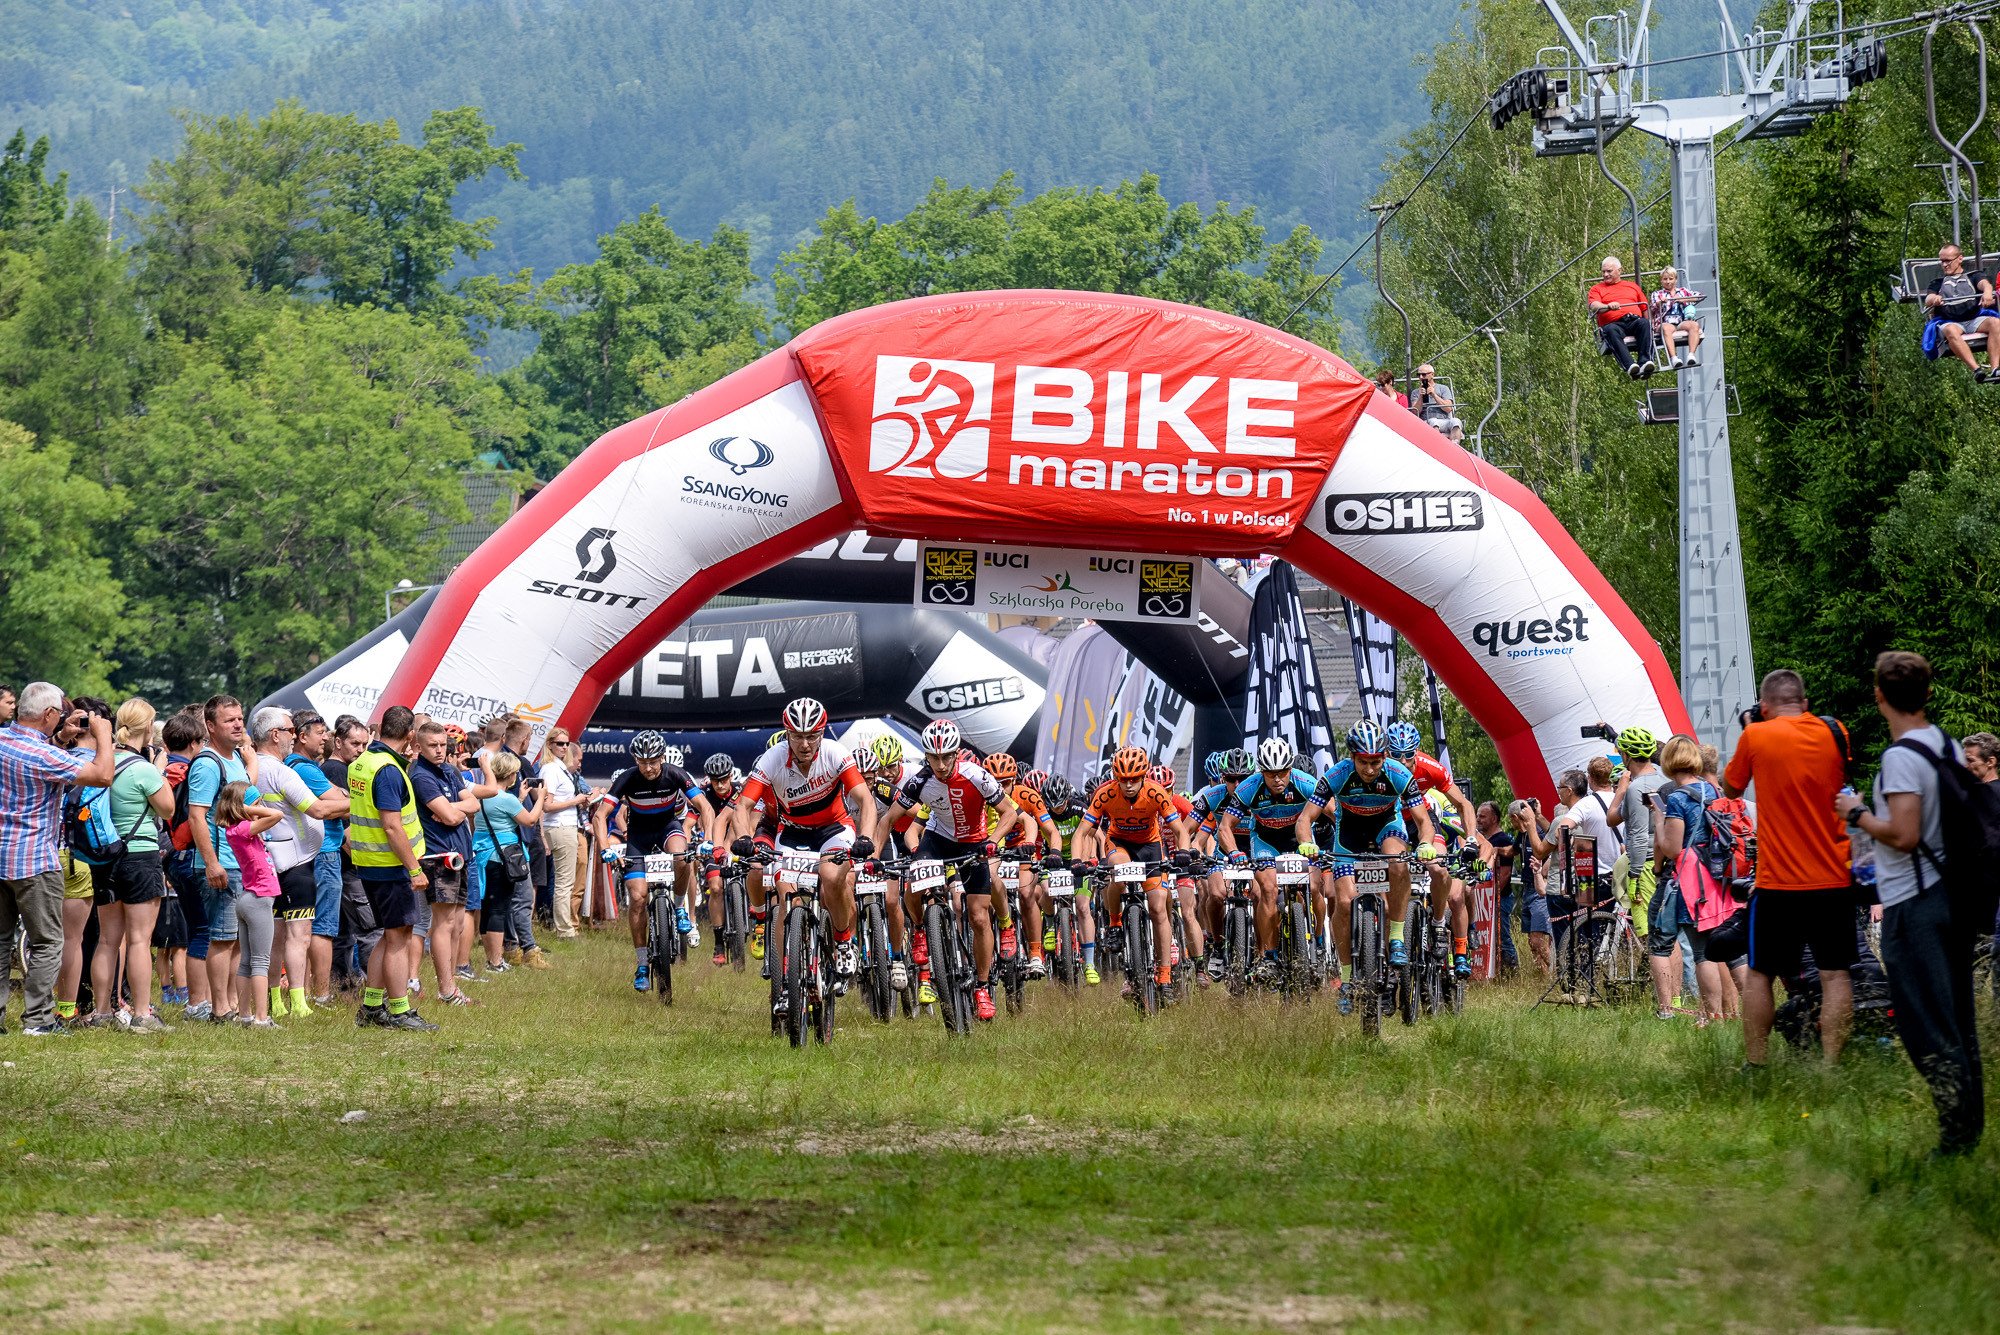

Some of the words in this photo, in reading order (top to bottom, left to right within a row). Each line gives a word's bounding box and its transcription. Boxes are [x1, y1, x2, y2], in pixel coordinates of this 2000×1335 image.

[1011, 365, 1298, 457] BIKE
[1009, 454, 1293, 498] maraton
[737, 505, 783, 518] PERFEKCJA
[1168, 508, 1196, 523] No.
[1201, 510, 1209, 523] 1
[1214, 513, 1228, 524] w
[1232, 511, 1290, 526] Polsce!
[1334, 496, 1476, 531] OSHEE
[926, 551, 973, 566] BIKE
[993, 552, 1029, 569] UCI
[1098, 557, 1134, 574] UCI
[927, 565, 975, 576] WEEK
[1142, 563, 1190, 578] BIKE
[1143, 577, 1192, 588] WEEK
[527, 580, 647, 609] SCOTT
[989, 592, 1064, 611] Szklarska
[1070, 596, 1124, 613] Poręba
[1473, 604, 1589, 657] quest
[801, 647, 853, 659] SZOSOWY
[801, 653, 854, 668] KLASYK
[1507, 646, 1574, 660] sportswear
[604, 637, 786, 699] ETA
[321, 681, 382, 701] REGATT
[928, 680, 1022, 710] OSHEE
[427, 687, 508, 715] REGATTA
[423, 704, 466, 722] GREAT
[580, 742, 625, 753] EAŃSKA
[1020, 790, 1043, 810] CCC
[1093, 788, 1116, 809] CCC
[1147, 788, 1169, 810] CCC
[1116, 816, 1151, 825] CCC
[647, 860, 672, 873] 2422
[785, 857, 817, 872] 1527
[912, 864, 942, 880] 1610
[1117, 867, 1144, 876] 3058
[1282, 860, 1303, 873] 158
[1050, 876, 1072, 887] 2916
[1357, 869, 1387, 883] 2099
